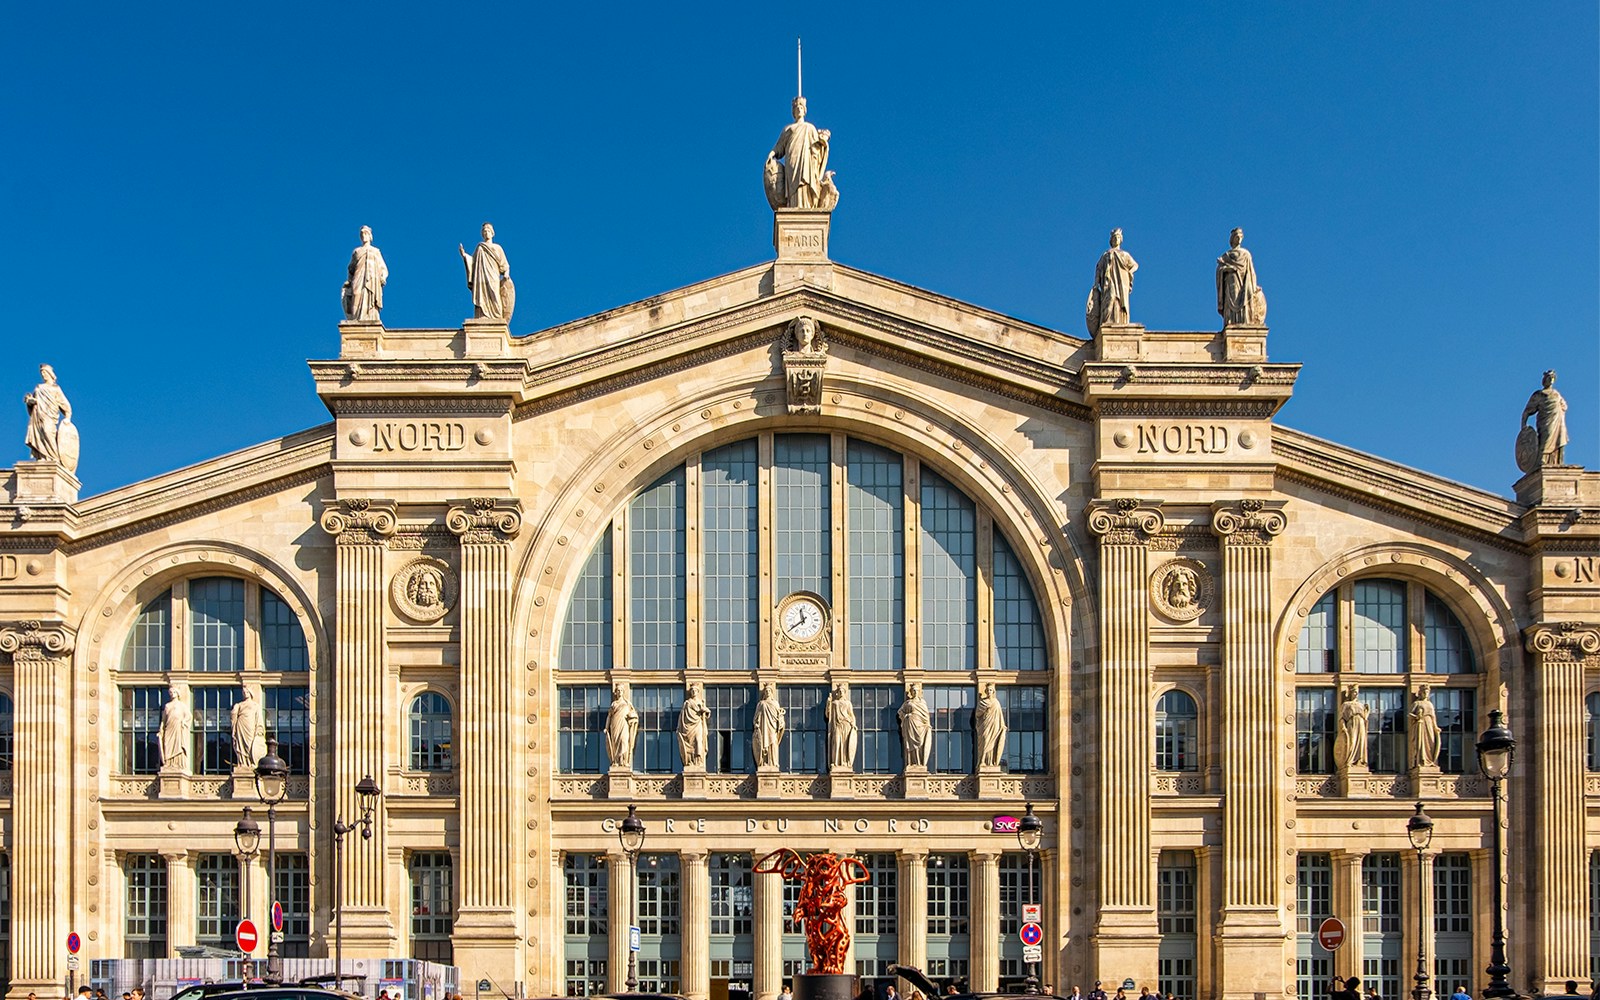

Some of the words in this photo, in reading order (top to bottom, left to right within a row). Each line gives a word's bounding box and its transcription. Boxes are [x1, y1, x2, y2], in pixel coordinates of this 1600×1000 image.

[787, 235, 820, 247] PARIS
[372, 423, 466, 452] NORD
[1136, 424, 1228, 454] NORD
[602, 818, 706, 833] GRE
[746, 818, 789, 833] DU
[824, 818, 929, 833] NORD
[995, 821, 1021, 831] SNCF
